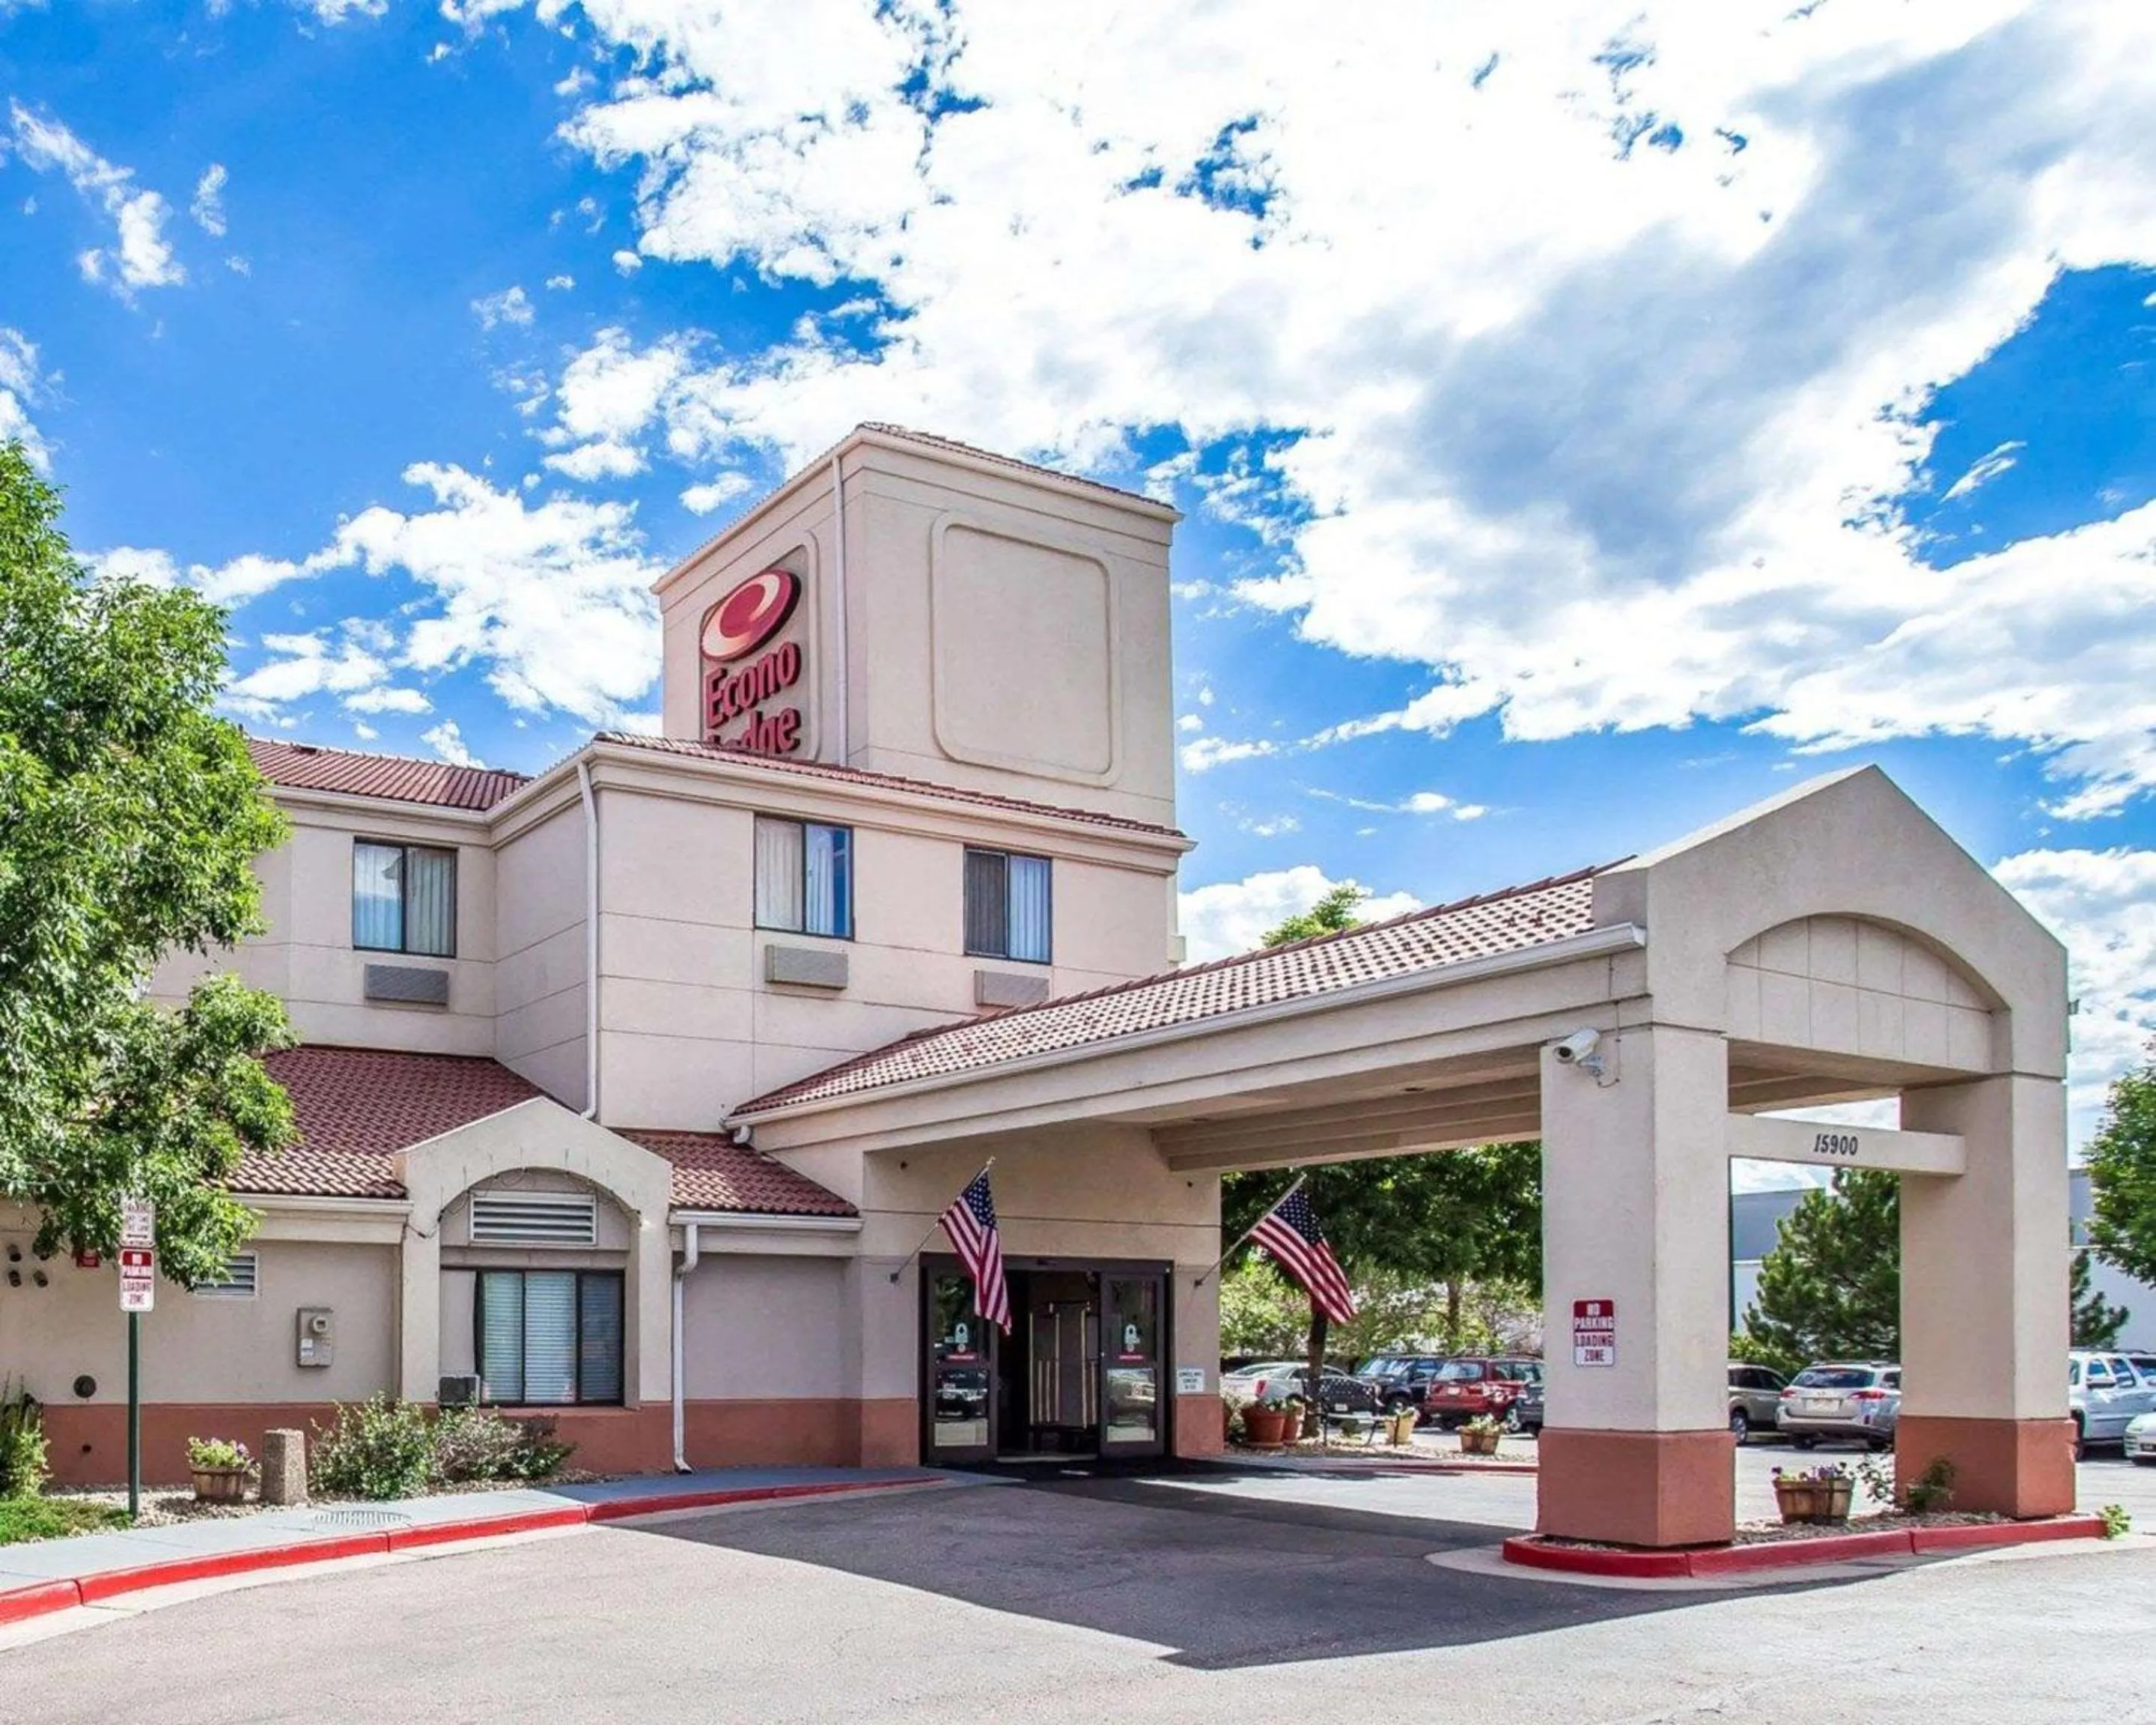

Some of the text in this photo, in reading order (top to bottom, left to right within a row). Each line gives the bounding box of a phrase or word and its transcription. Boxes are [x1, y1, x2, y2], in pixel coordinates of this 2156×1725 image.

[707, 642, 802, 729] Econo
[707, 707, 801, 755] dge
[1813, 1133, 1858, 1156] 15900
[1574, 1317, 1613, 1329] PARKING
[1574, 1335, 1613, 1347] LOADING
[1584, 1349, 1604, 1361] ZONE
